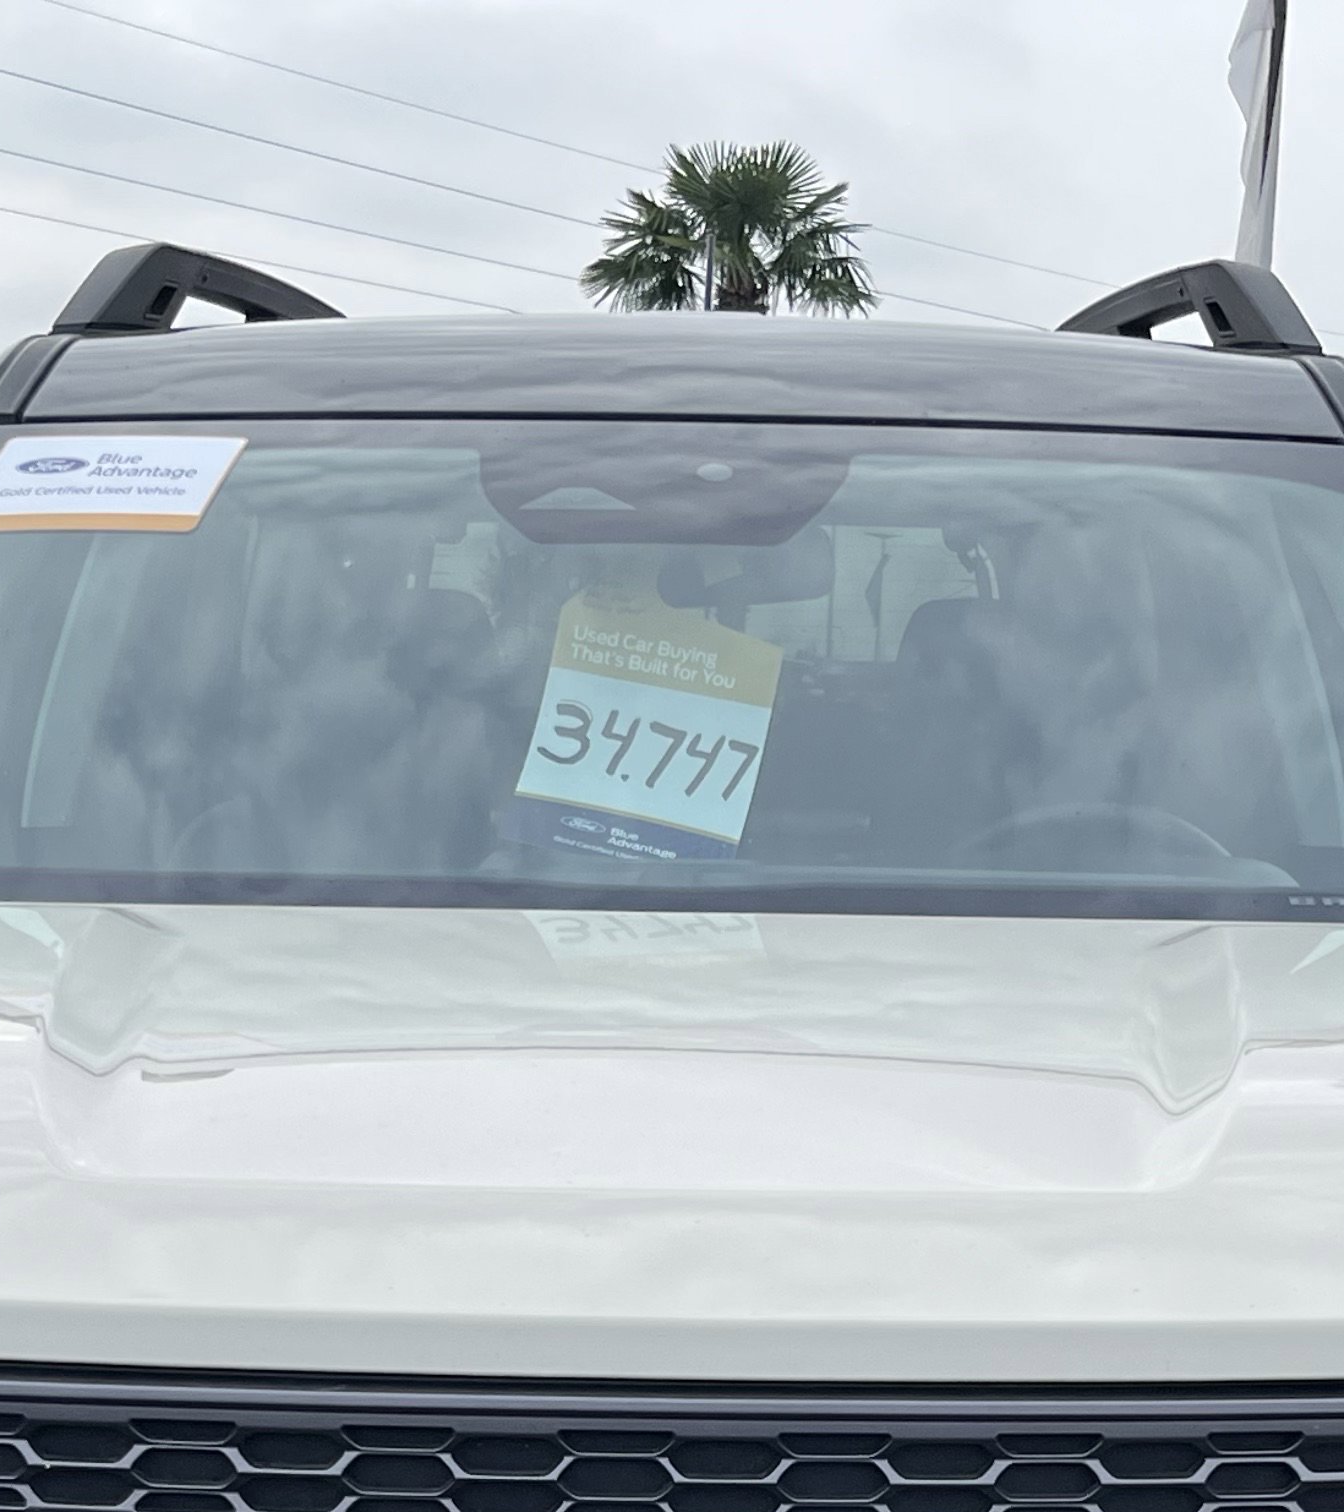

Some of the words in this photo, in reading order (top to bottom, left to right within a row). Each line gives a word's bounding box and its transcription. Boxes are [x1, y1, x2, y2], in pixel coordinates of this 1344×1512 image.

[97, 452, 143, 465] Blue
[87, 465, 198, 481] Advantage
[0, 487, 32, 498] Gold
[34, 486, 93, 497] Certified
[96, 485, 133, 496] Used
[136, 485, 186, 496] Vehicle
[573, 624, 620, 647] Used
[623, 634, 654, 653] Car
[658, 640, 718, 669] Buying
[571, 643, 625, 668] That's
[628, 655, 668, 676] Built
[672, 662, 698, 682] for
[703, 668, 737, 689] You
[610, 827, 640, 841] Blue
[607, 836, 677, 860] Advantage
